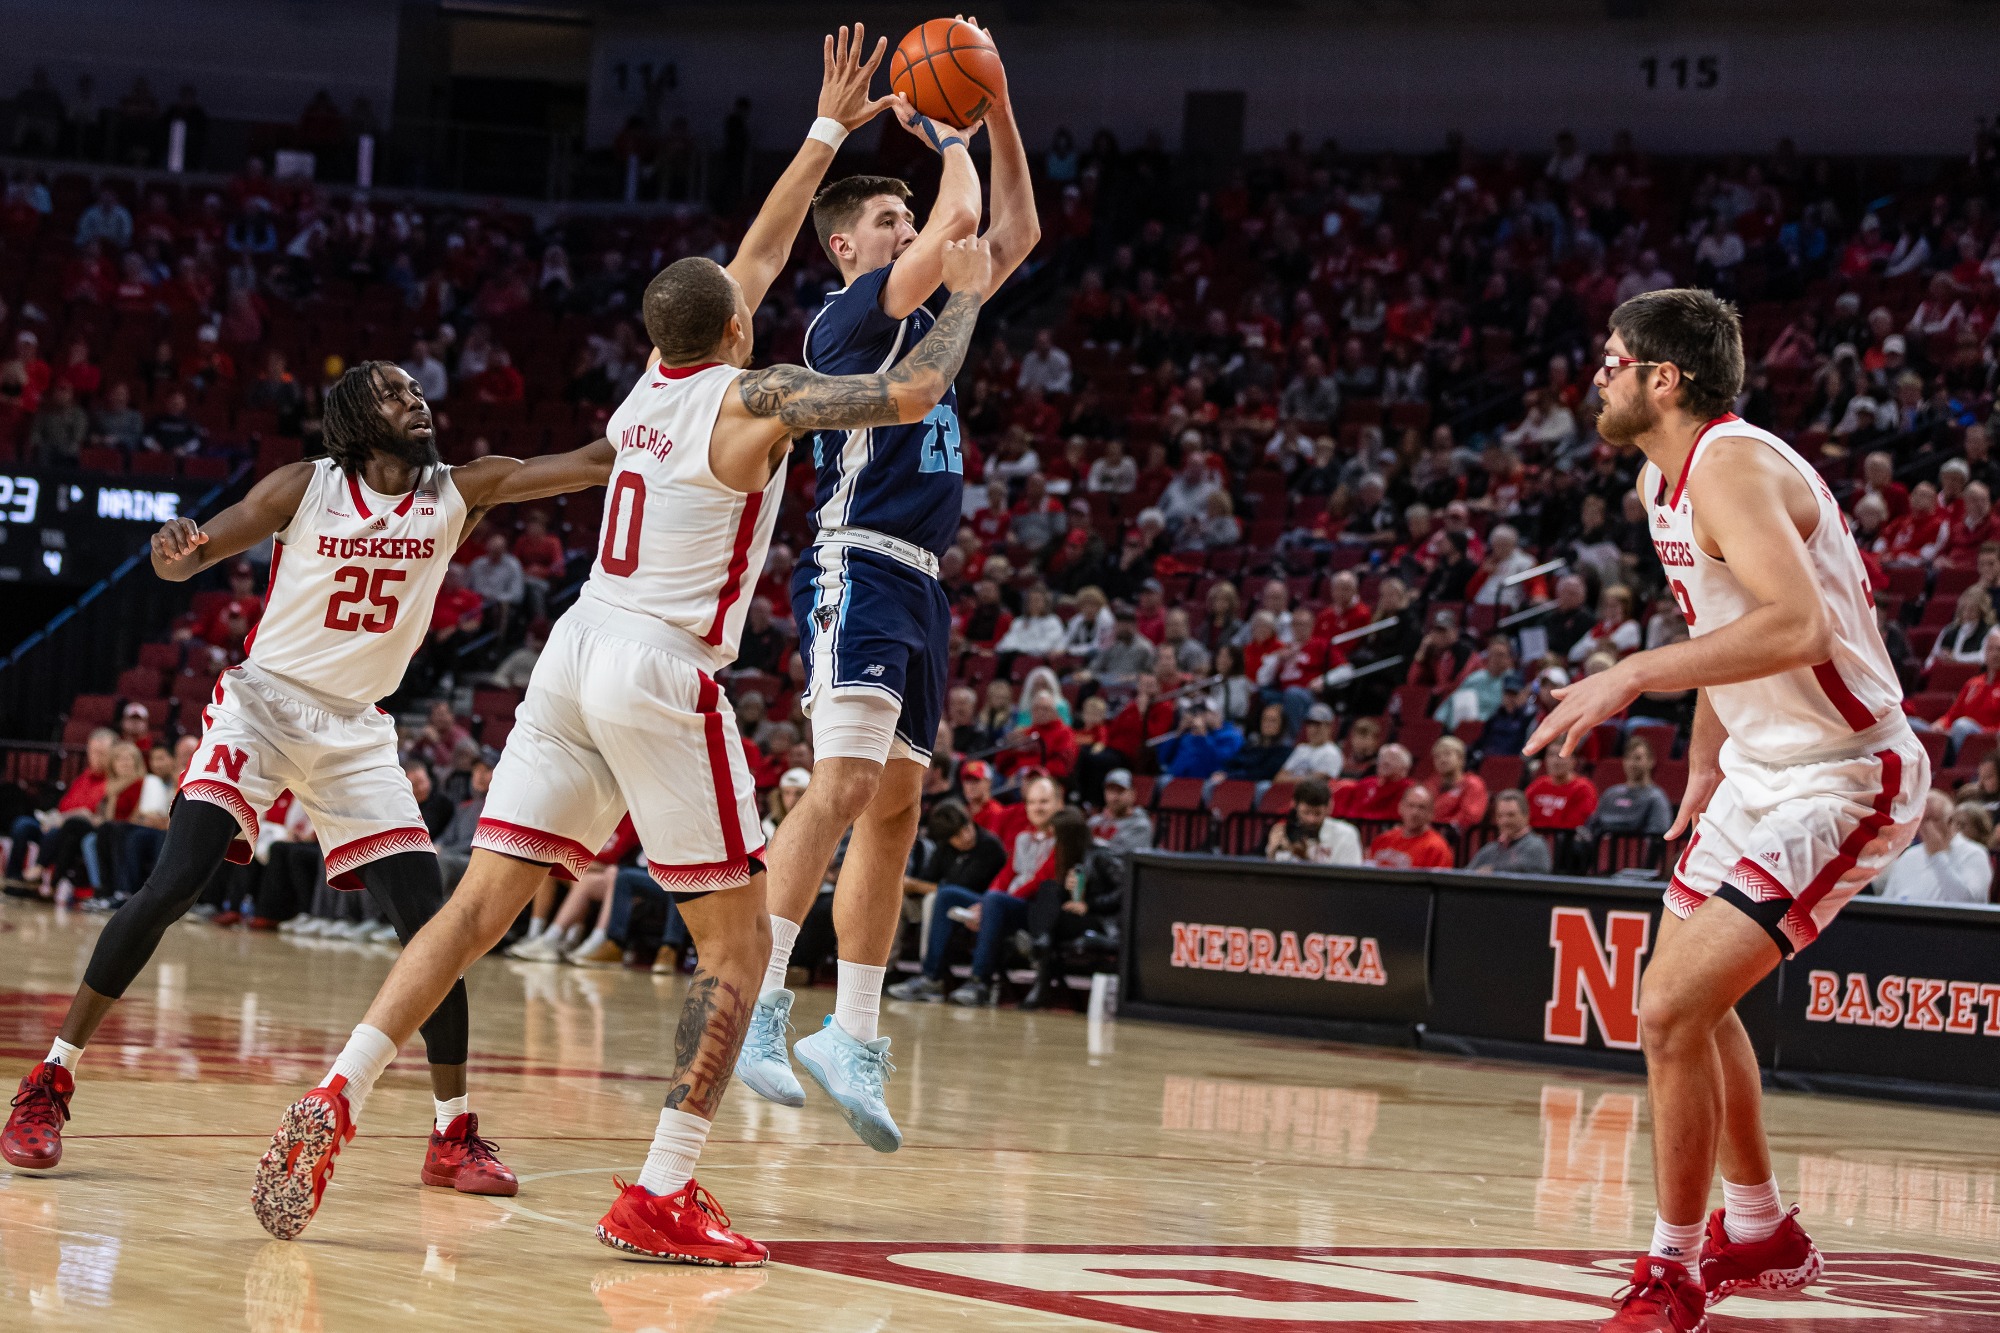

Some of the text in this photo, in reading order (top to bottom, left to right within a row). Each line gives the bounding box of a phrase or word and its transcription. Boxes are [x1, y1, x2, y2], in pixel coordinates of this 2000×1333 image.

[1640, 56, 1718, 89] 115
[621, 425, 673, 463] WLCHER
[918, 404, 963, 475] 22
[97, 487, 180, 523] MAINE
[601, 470, 647, 578] 0
[317, 535, 435, 559] HUSKERS
[1653, 540, 1695, 567] SKERS
[324, 566, 406, 633] 25
[204, 744, 250, 784] N
[1171, 922, 1387, 986] NEBRASKA
[1544, 907, 1651, 1050] N
[1806, 970, 2000, 1037] BASKET
